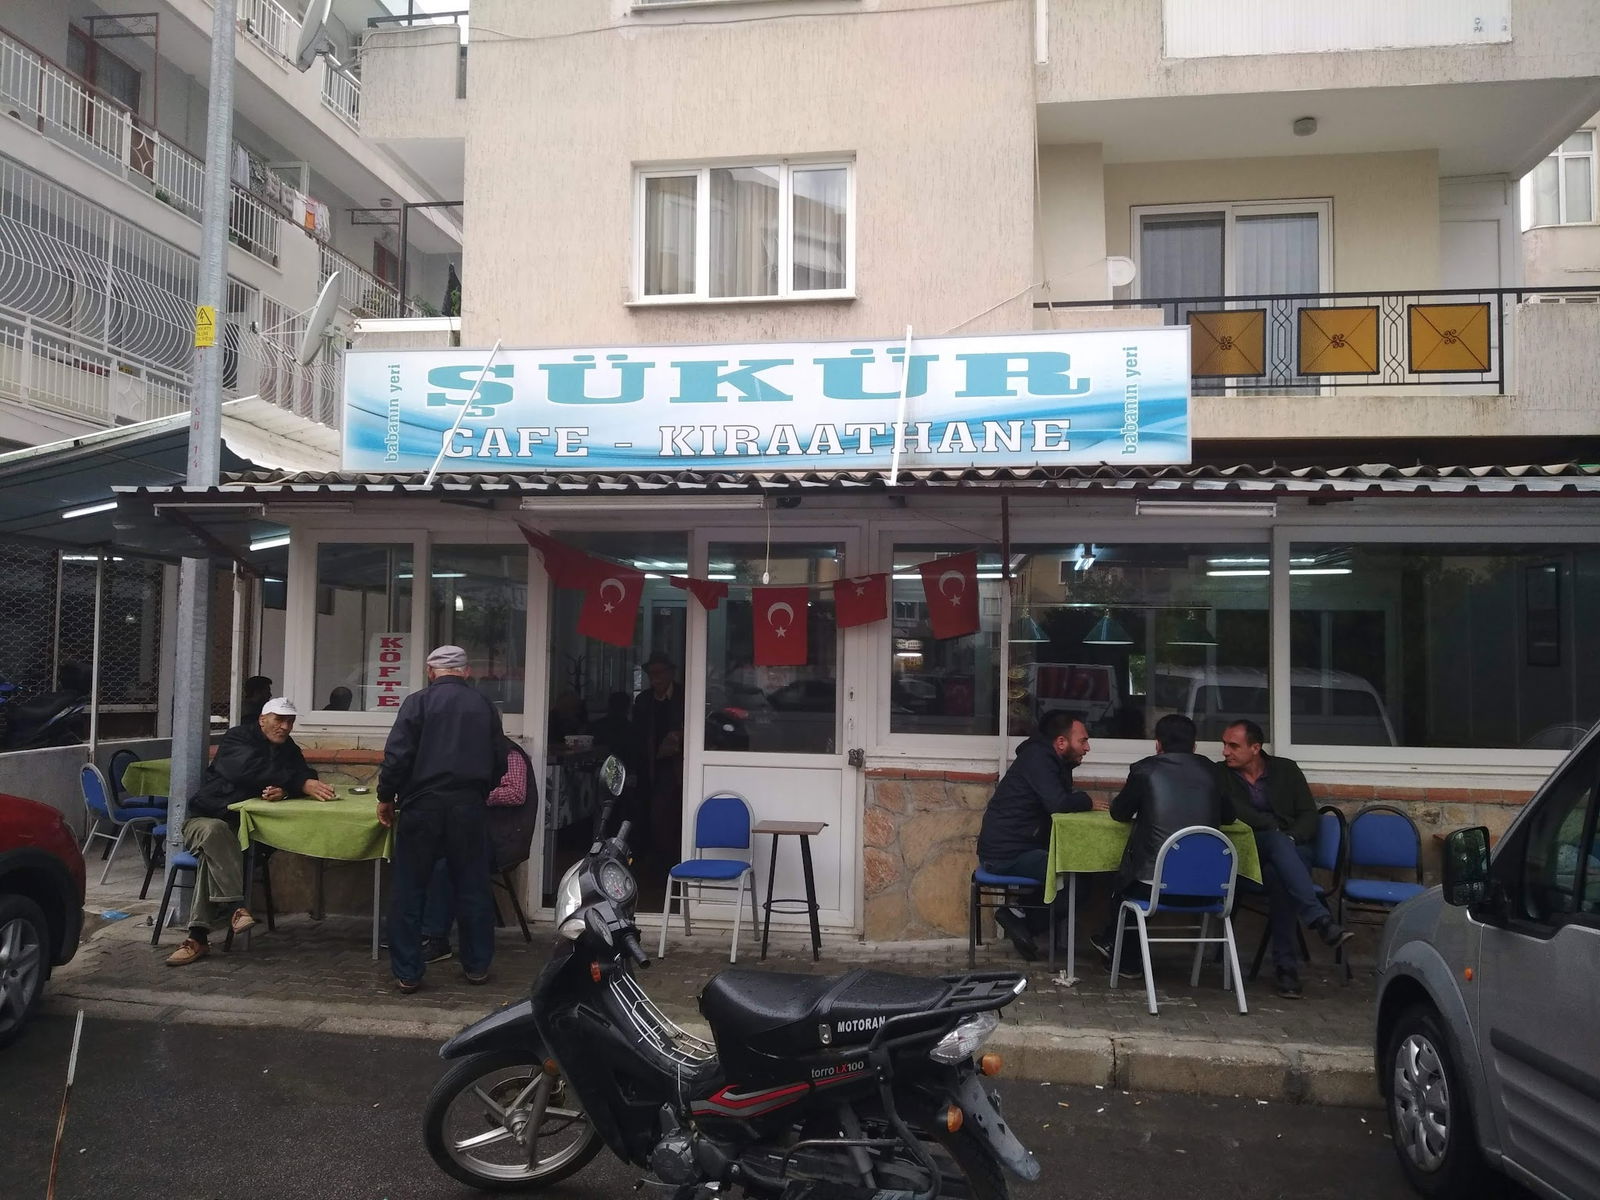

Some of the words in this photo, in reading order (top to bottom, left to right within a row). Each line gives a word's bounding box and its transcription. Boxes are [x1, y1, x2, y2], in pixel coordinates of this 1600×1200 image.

[388, 364, 403, 393] yeri
[426, 347, 1091, 418] ŞÜKÜR
[1123, 346, 1141, 378] yeri
[384, 398, 399, 463] babanın
[441, 426, 590, 458] CAFE
[658, 419, 1071, 457] KIRAATHANE
[1121, 383, 1138, 455] babanın
[377, 637, 403, 707] KÖFTE
[837, 1016, 886, 1033] MOTORAN
